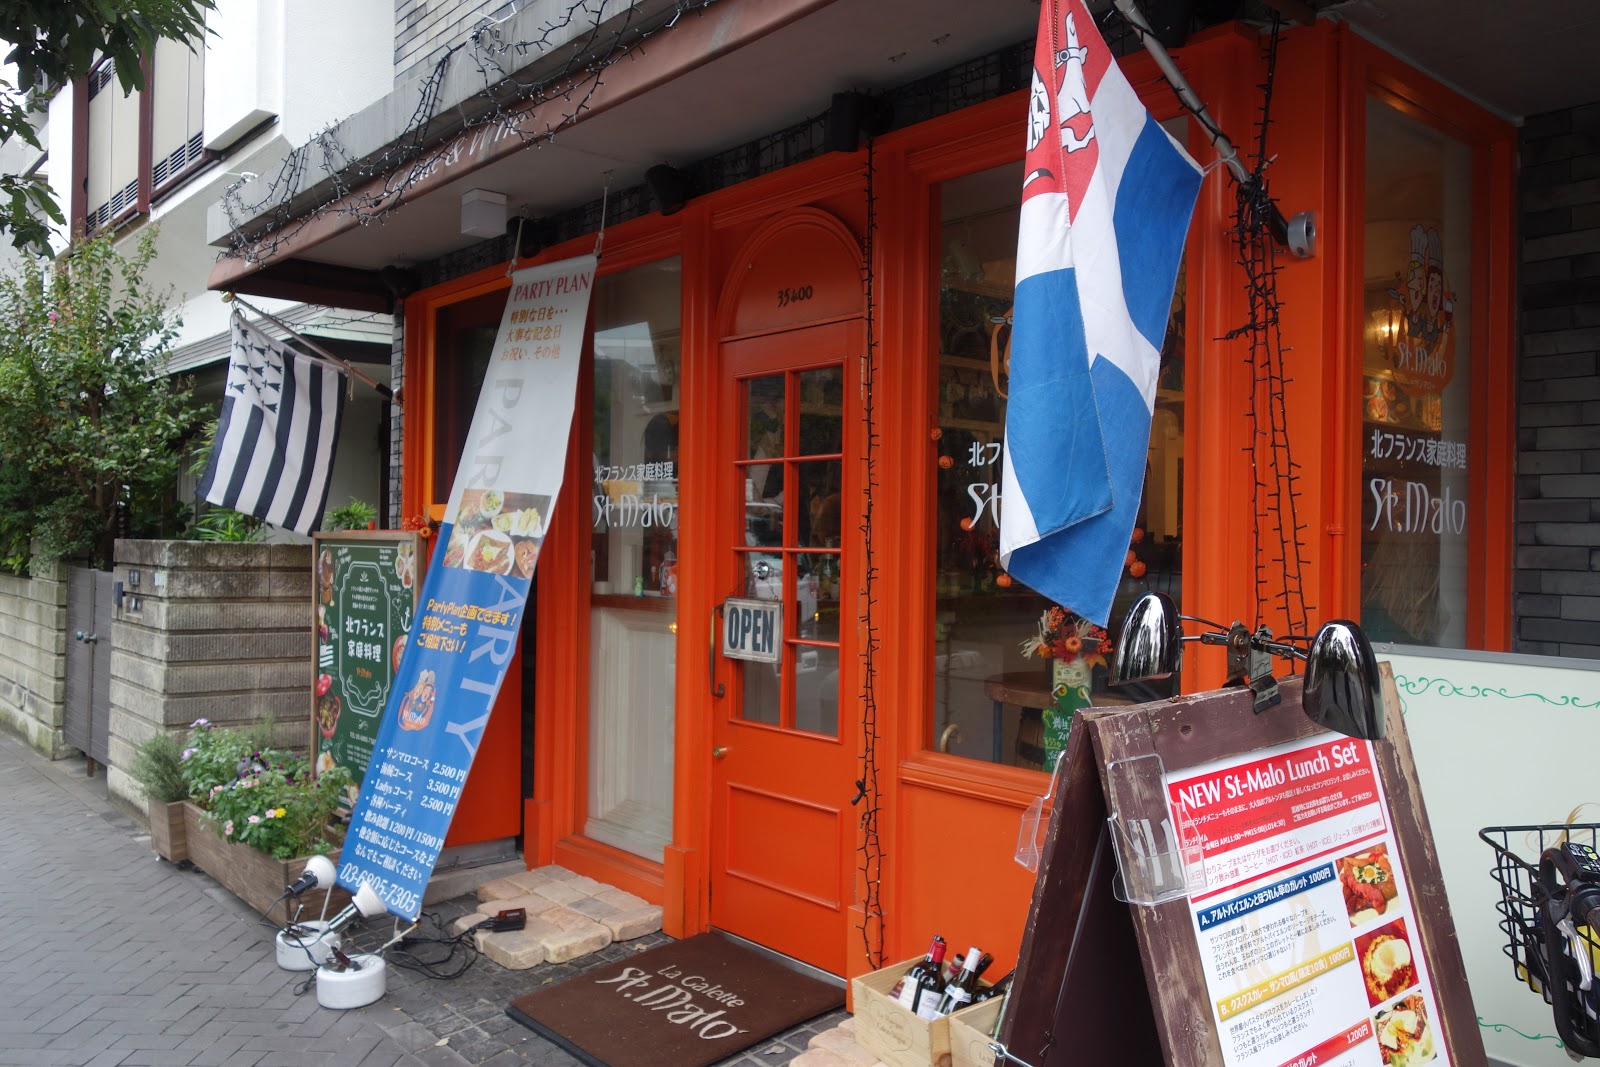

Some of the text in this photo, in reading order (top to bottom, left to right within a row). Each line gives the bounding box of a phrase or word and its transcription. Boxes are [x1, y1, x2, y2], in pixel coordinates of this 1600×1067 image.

[514, 272, 590, 302] PARTY PLAN
[504, 325, 562, 343] 大事な記念日
[465, 378, 527, 490] PAR
[1371, 429, 1467, 469] 北フランス家庭料理
[594, 461, 674, 484] 北フランス家庭料理
[593, 493, 674, 528] St.Malo
[1370, 478, 1466, 535] St.Malo
[345, 614, 385, 638] 北フランス
[421, 615, 468, 637] 特別メニューも
[728, 607, 775, 654] OPEN
[347, 639, 382, 662] 家庭料理
[416, 633, 467, 653] ご相談下さい！
[445, 574, 526, 758] ARTY
[386, 747, 430, 770] サンマロコース
[1178, 742, 1360, 811] NEW St-Malo Lunch Set
[370, 793, 407, 818] 各種パーティ
[363, 810, 389, 831] 飲み放題
[354, 842, 422, 884] なんでもご相談ください。
[1200, 866, 1331, 926] A. アルトバイエルンとほうれん草のガレット 1000円
[657, 965, 682, 979] La
[1229, 984, 1268, 1013] クスクスカレー
[1328, 945, 1351, 965] 1000円
[1346, 1024, 1369, 1044] 1200円
